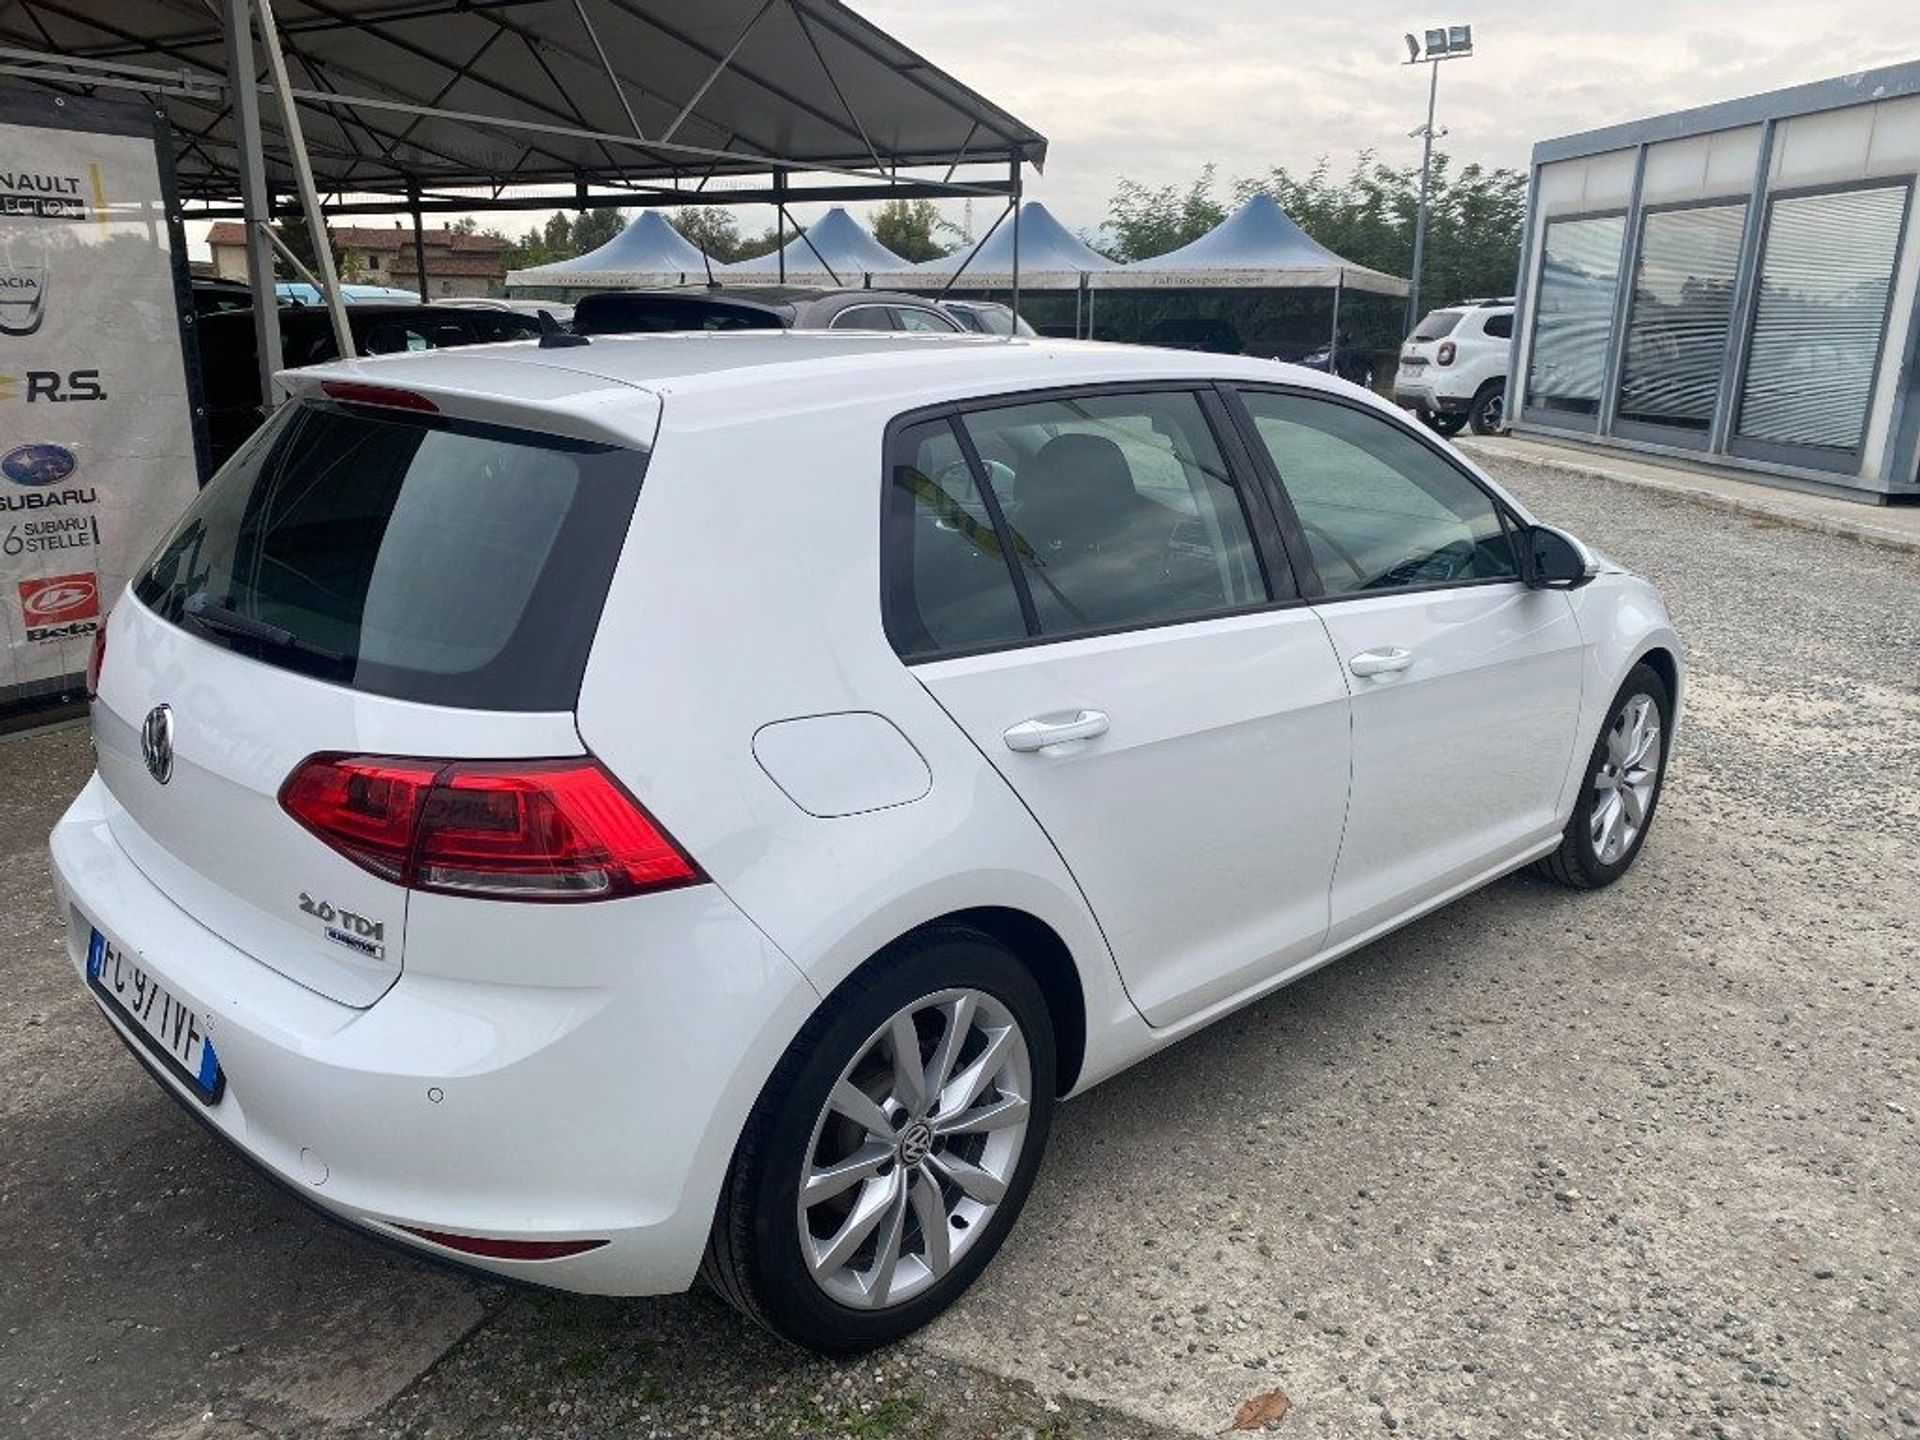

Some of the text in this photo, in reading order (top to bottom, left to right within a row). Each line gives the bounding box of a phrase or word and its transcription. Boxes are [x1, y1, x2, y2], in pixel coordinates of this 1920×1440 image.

[0, 197, 77, 216] ECTION
[26, 370, 107, 402] R.S.
[0, 488, 96, 511] SUBARU
[24, 517, 87, 536] SUBARU
[4, 525, 24, 555] 6
[26, 532, 89, 552] STELLE
[298, 891, 383, 941] 2.0 TDI
